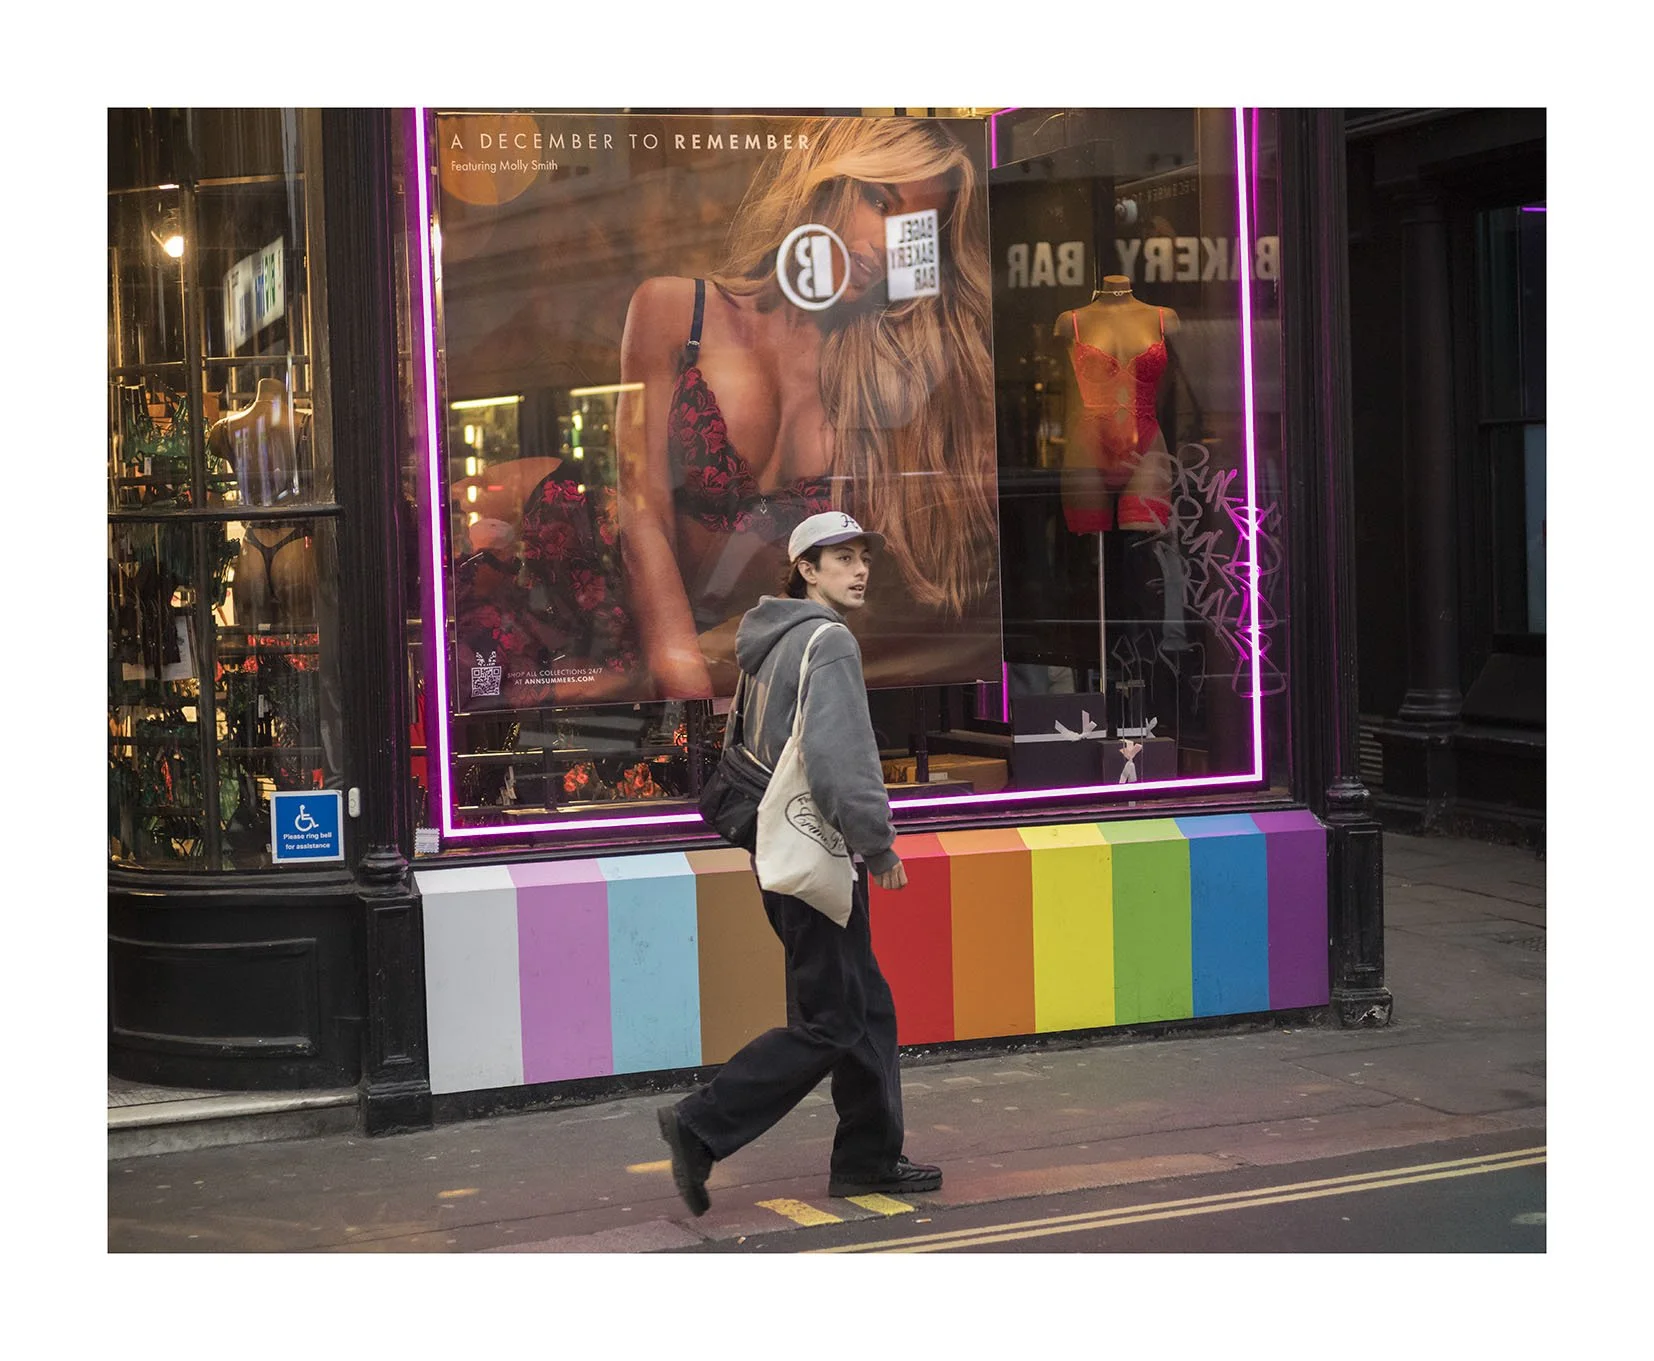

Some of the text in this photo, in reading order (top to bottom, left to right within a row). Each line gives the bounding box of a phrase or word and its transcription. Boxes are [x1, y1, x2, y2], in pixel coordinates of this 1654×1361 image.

[450, 133, 810, 150] A DECEMBER TO REMEMBER
[451, 159, 558, 174] Featuring Molly Smith
[507, 667, 603, 679] SHOP ALL COLLECTIONS 24/7
[524, 676, 595, 686] ANNSUMMERS.COM
[306, 832, 319, 840] ring
